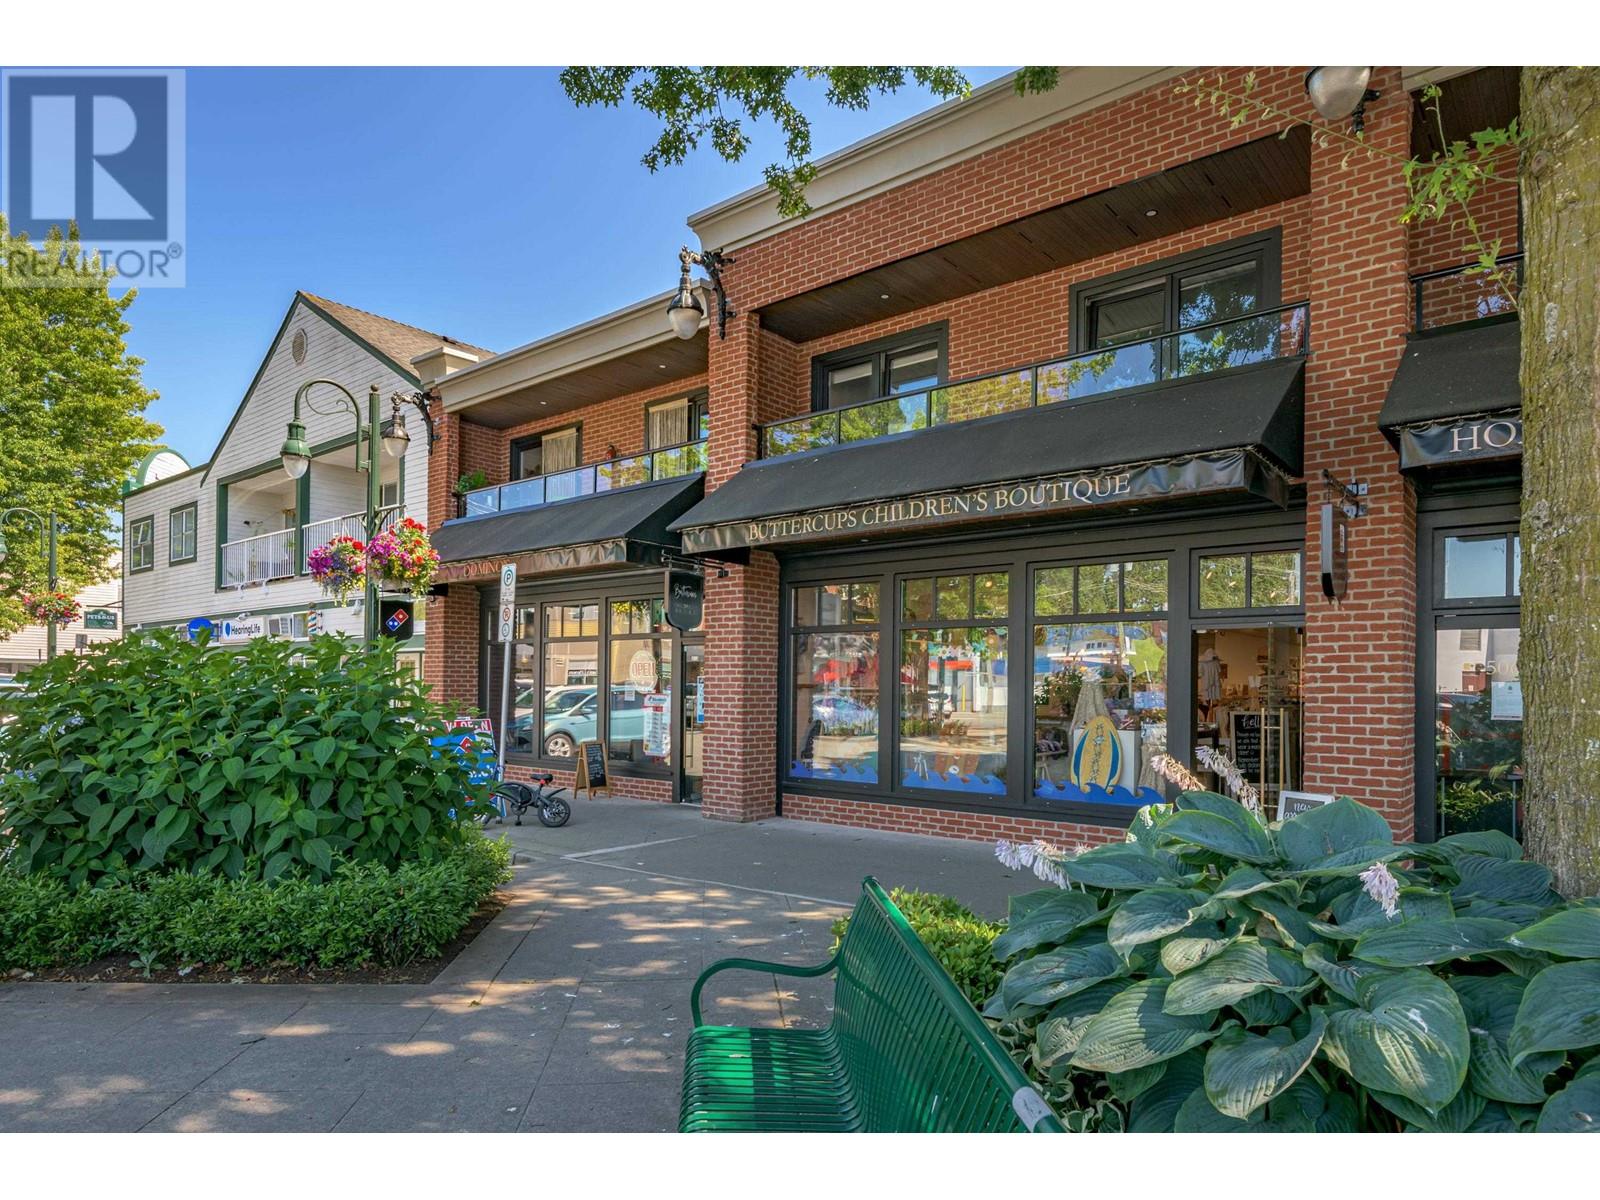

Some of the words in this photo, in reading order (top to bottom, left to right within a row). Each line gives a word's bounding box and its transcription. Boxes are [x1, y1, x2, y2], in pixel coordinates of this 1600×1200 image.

[1450, 421, 1522, 453] HO
[749, 509, 857, 541] BUTTERCUPS
[861, 491, 988, 526] CHILDREN'S
[994, 473, 1131, 510] BOUTIQUE
[231, 623, 261, 636] HearingLife
[632, 662, 656, 677] OPEN
